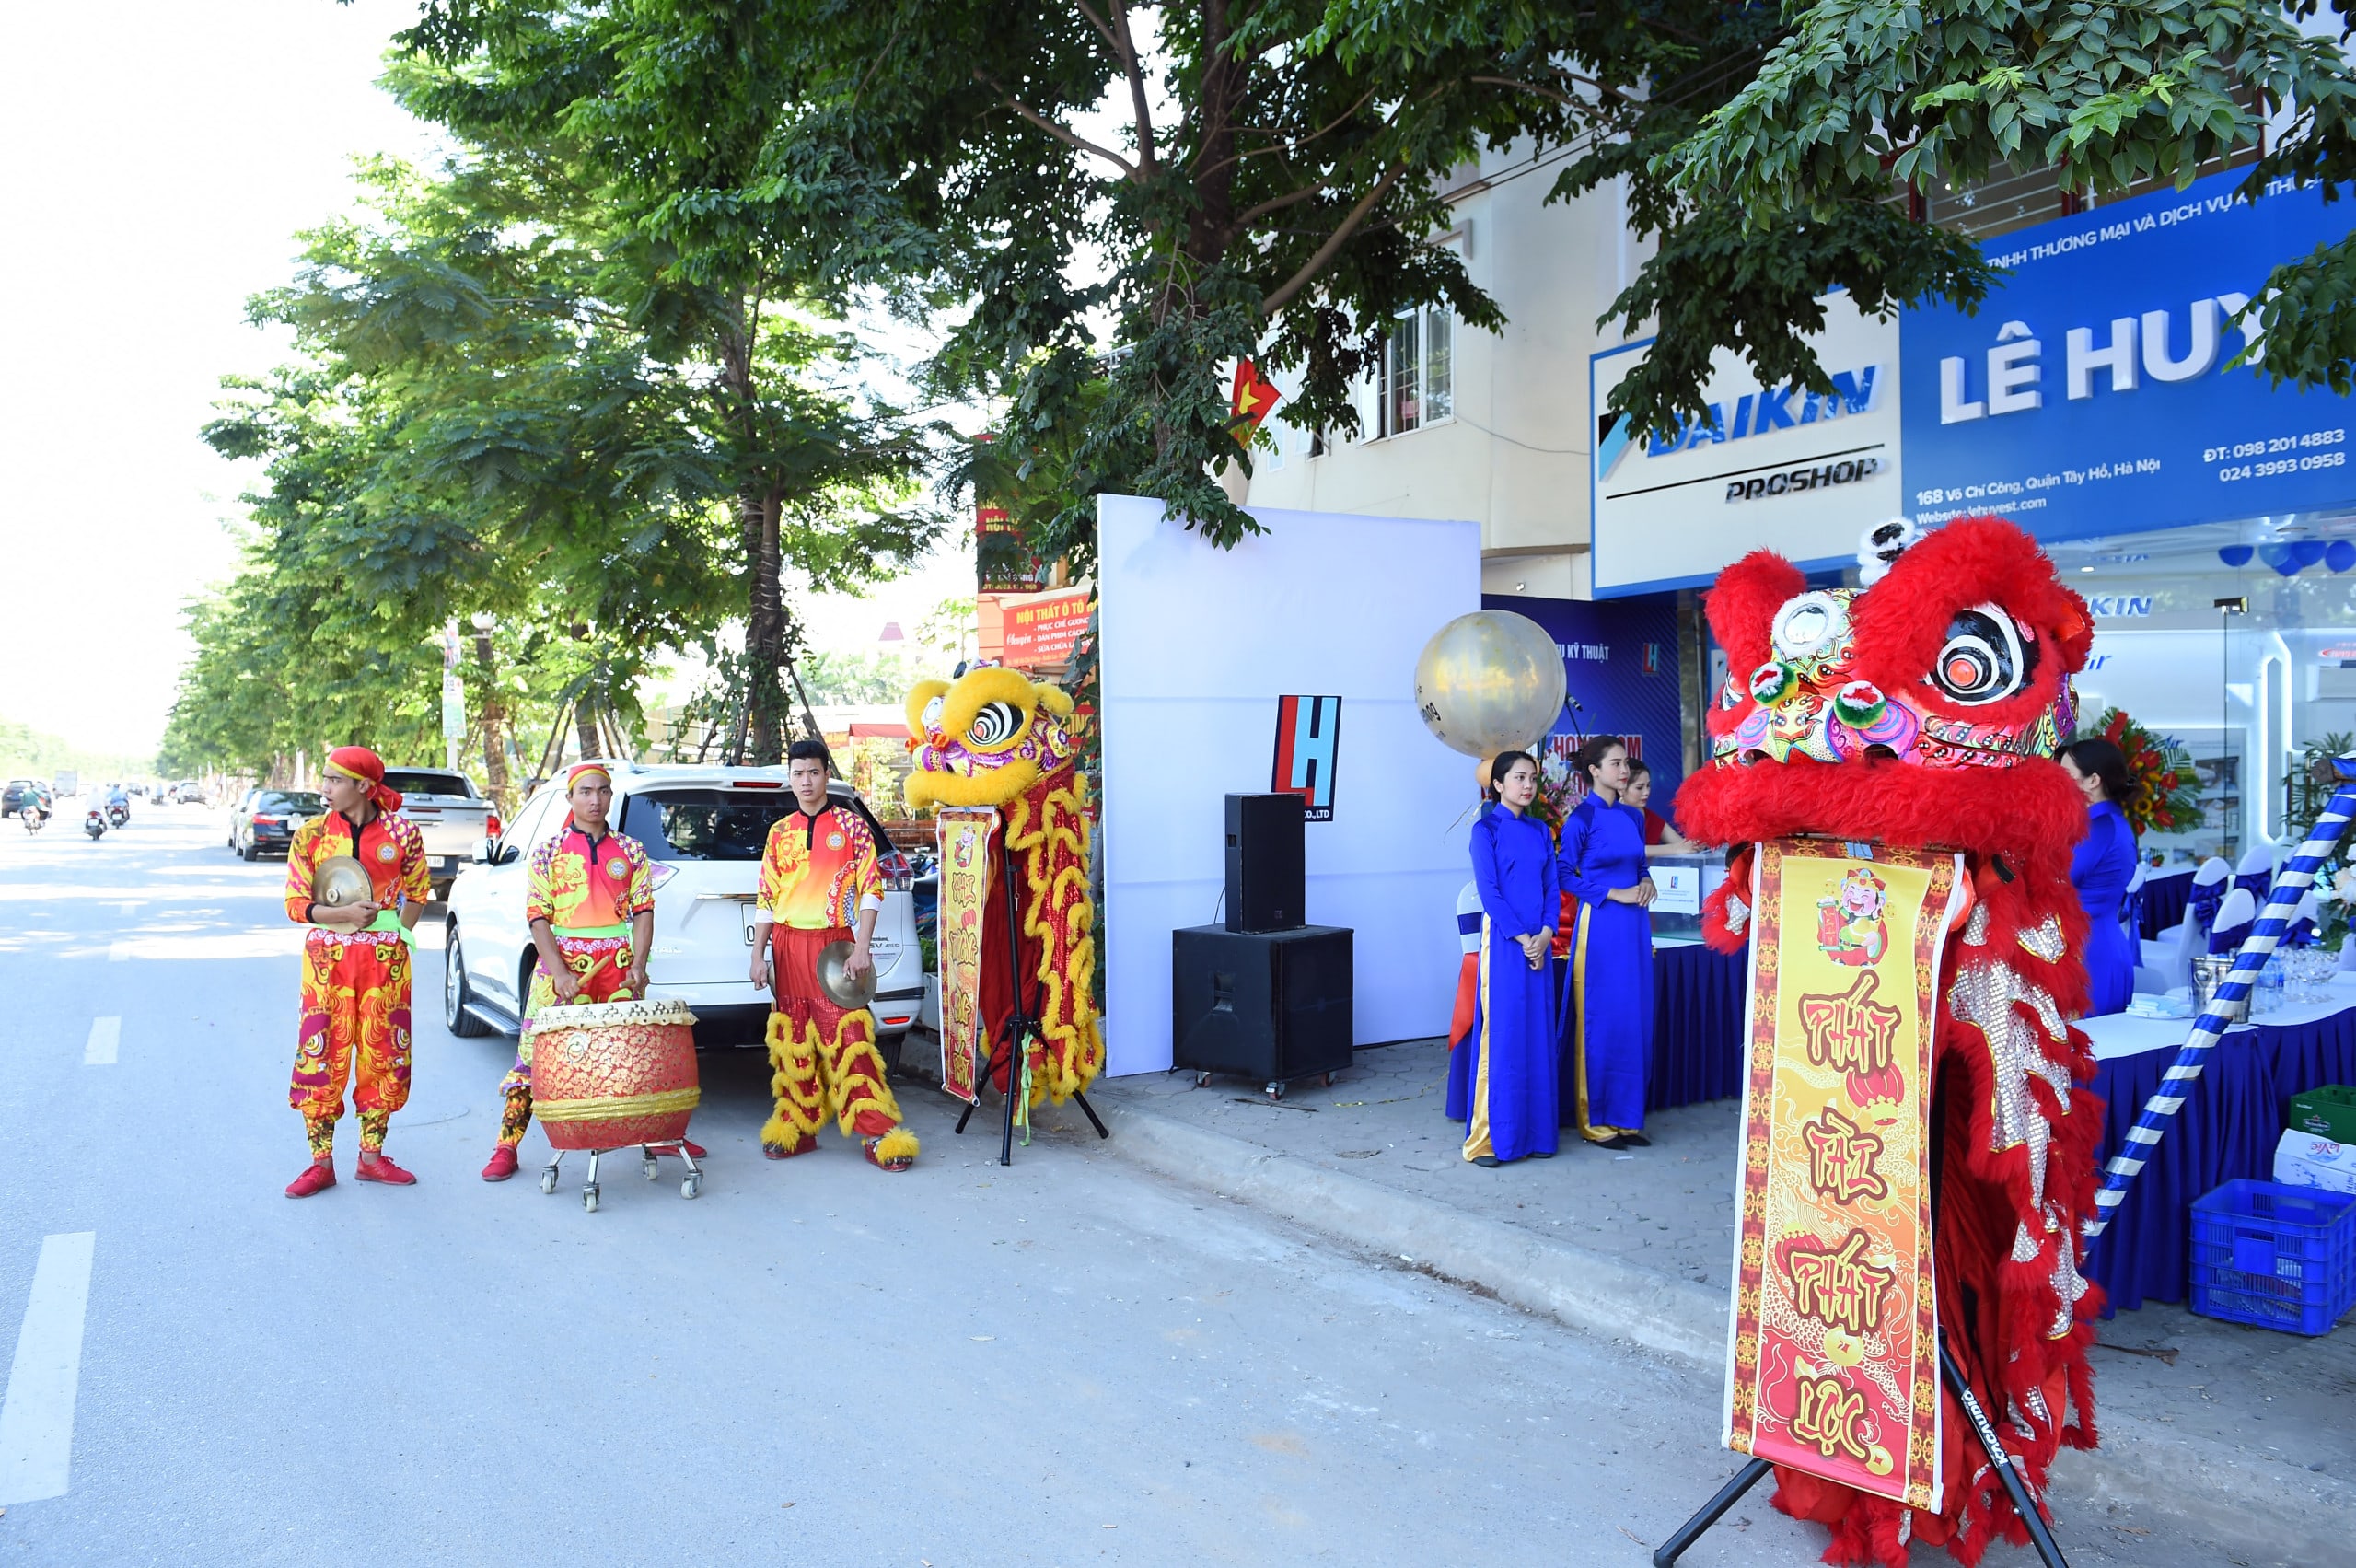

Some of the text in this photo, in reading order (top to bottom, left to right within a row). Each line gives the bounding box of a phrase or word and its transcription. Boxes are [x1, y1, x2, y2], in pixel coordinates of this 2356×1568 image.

[1986, 250, 2027, 270] TNHH
[2029, 230, 2098, 261] THƯƠNG
[2099, 221, 2130, 242] MẠI
[2133, 213, 2156, 232] VÀ
[2159, 204, 2203, 226] DỊCH
[2206, 193, 2234, 214] VỤ
[1940, 287, 2283, 425] LÊ HUY
[2202, 428, 2346, 463] ĐT: 098 201 4883
[2219, 451, 2347, 482] 024 3993 0958
[1724, 457, 1880, 505] PROSHOP
[1916, 457, 2161, 506] 168 Võ Chí Công, Quận Tây Hồ, Hà Nội
[1016, 608, 1034, 625] NỘI
[1035, 601, 1060, 621] THẤT
[1062, 600, 1070, 617] Ô
[1071, 598, 1085, 615] TÔ
[1567, 642, 1580, 659] KỸ
[1581, 643, 1609, 663] THUẬT
[1801, 971, 1899, 1077] PHÁT
[1805, 1110, 1884, 1202] TÀI
[1789, 1232, 1891, 1332] PHÁT
